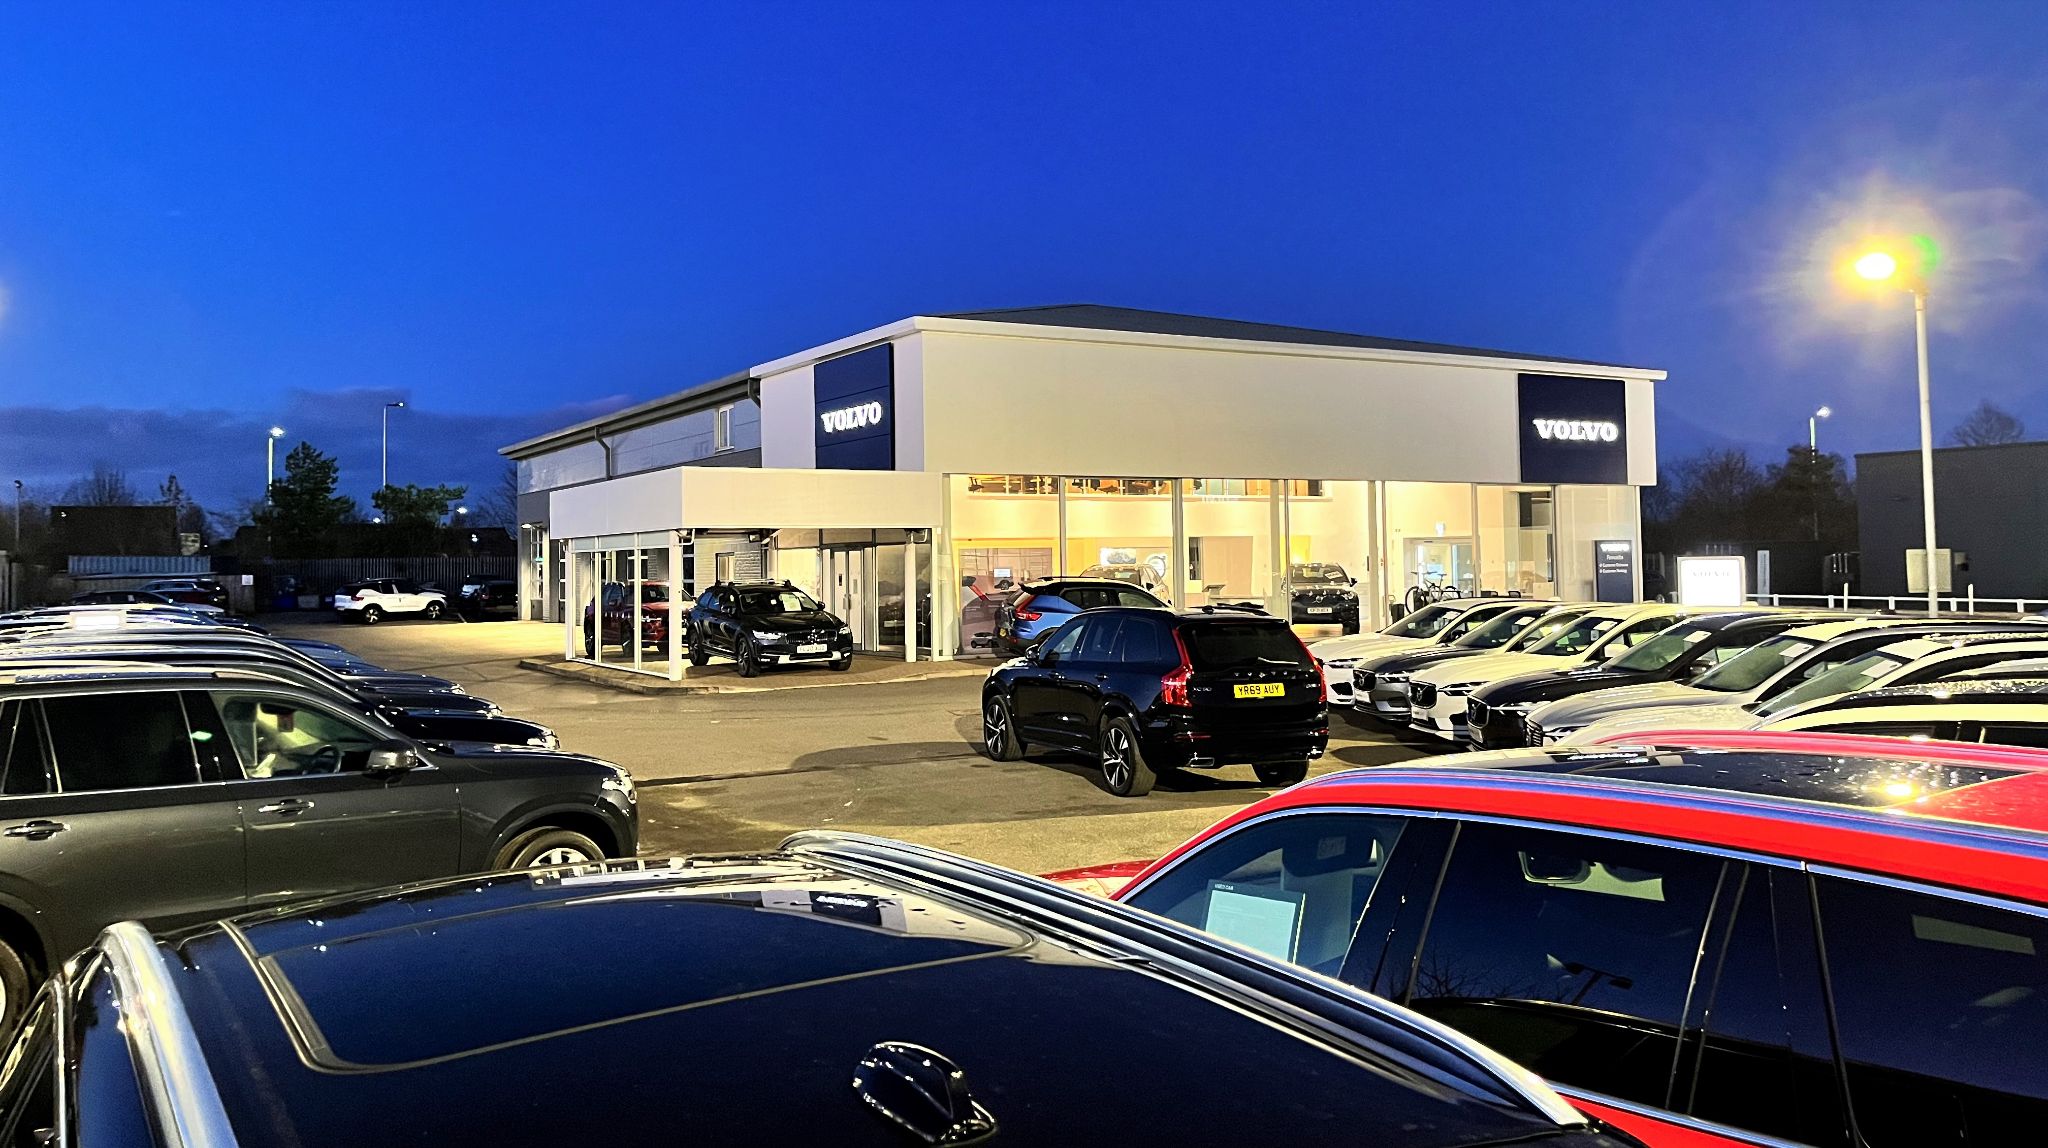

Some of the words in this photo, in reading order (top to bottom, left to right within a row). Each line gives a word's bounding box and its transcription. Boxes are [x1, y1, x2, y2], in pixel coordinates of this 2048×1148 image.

[821, 401, 882, 433] VOLVO
[1533, 419, 1619, 442] VOLVO
[1238, 685, 1261, 695] YR69
[1264, 684, 1279, 694] AUY
